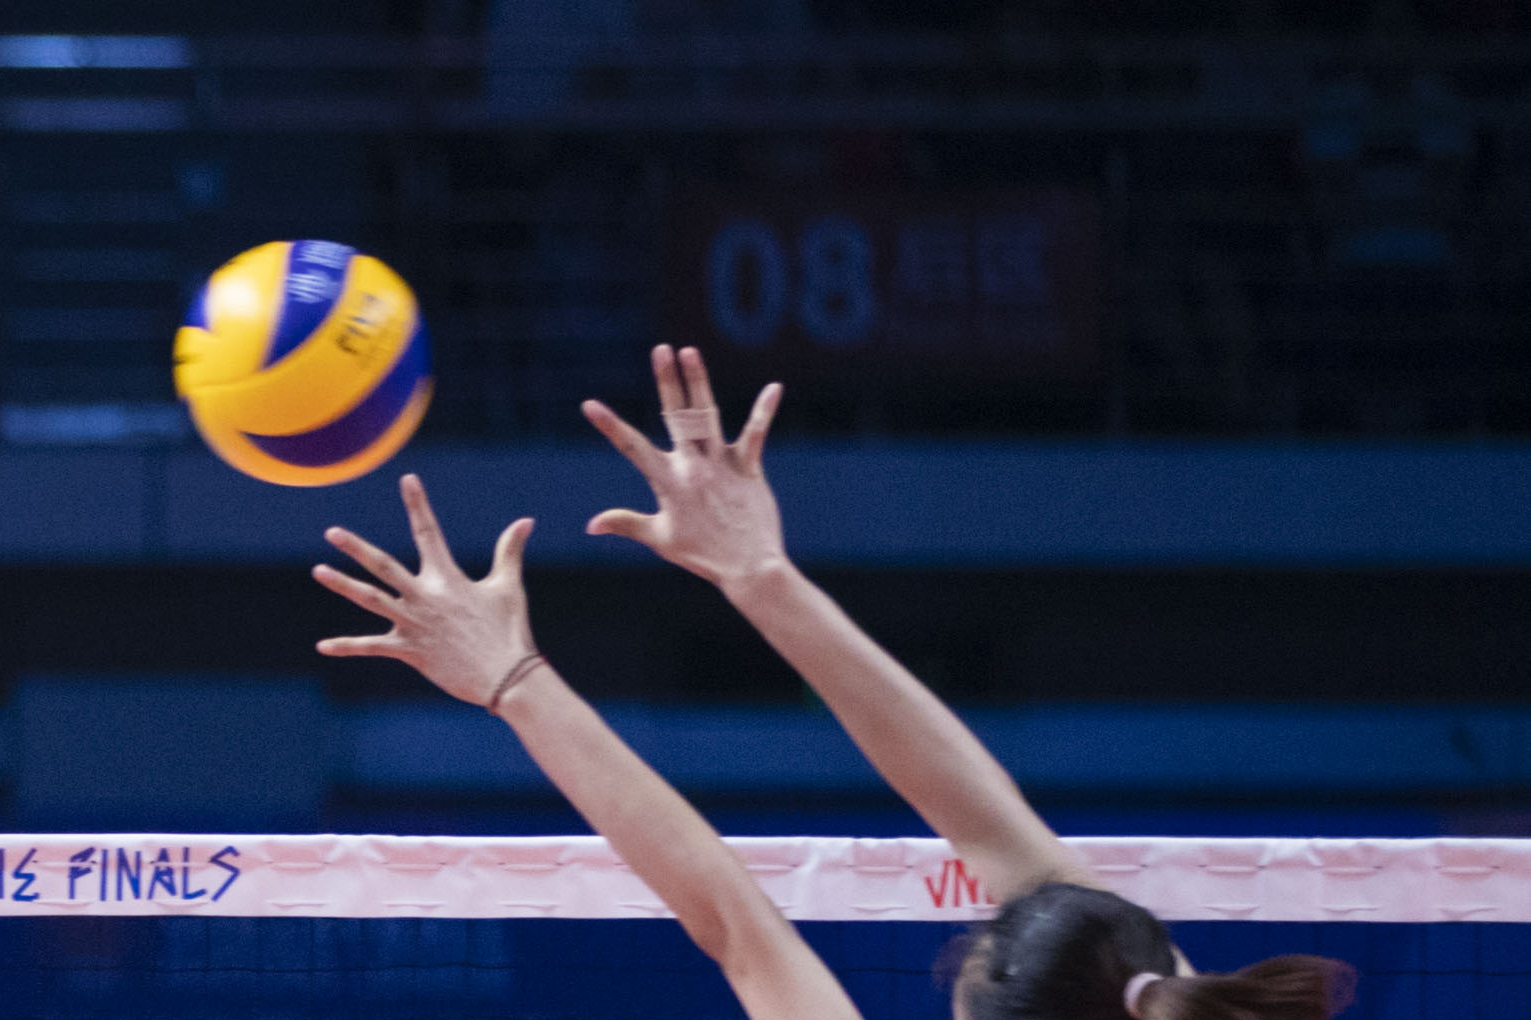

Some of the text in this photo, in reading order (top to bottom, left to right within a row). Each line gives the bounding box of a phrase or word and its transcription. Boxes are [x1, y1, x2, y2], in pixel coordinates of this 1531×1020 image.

[707, 213, 876, 346] 08
[67, 845, 240, 901] FINALS
[924, 859, 993, 908] VN
